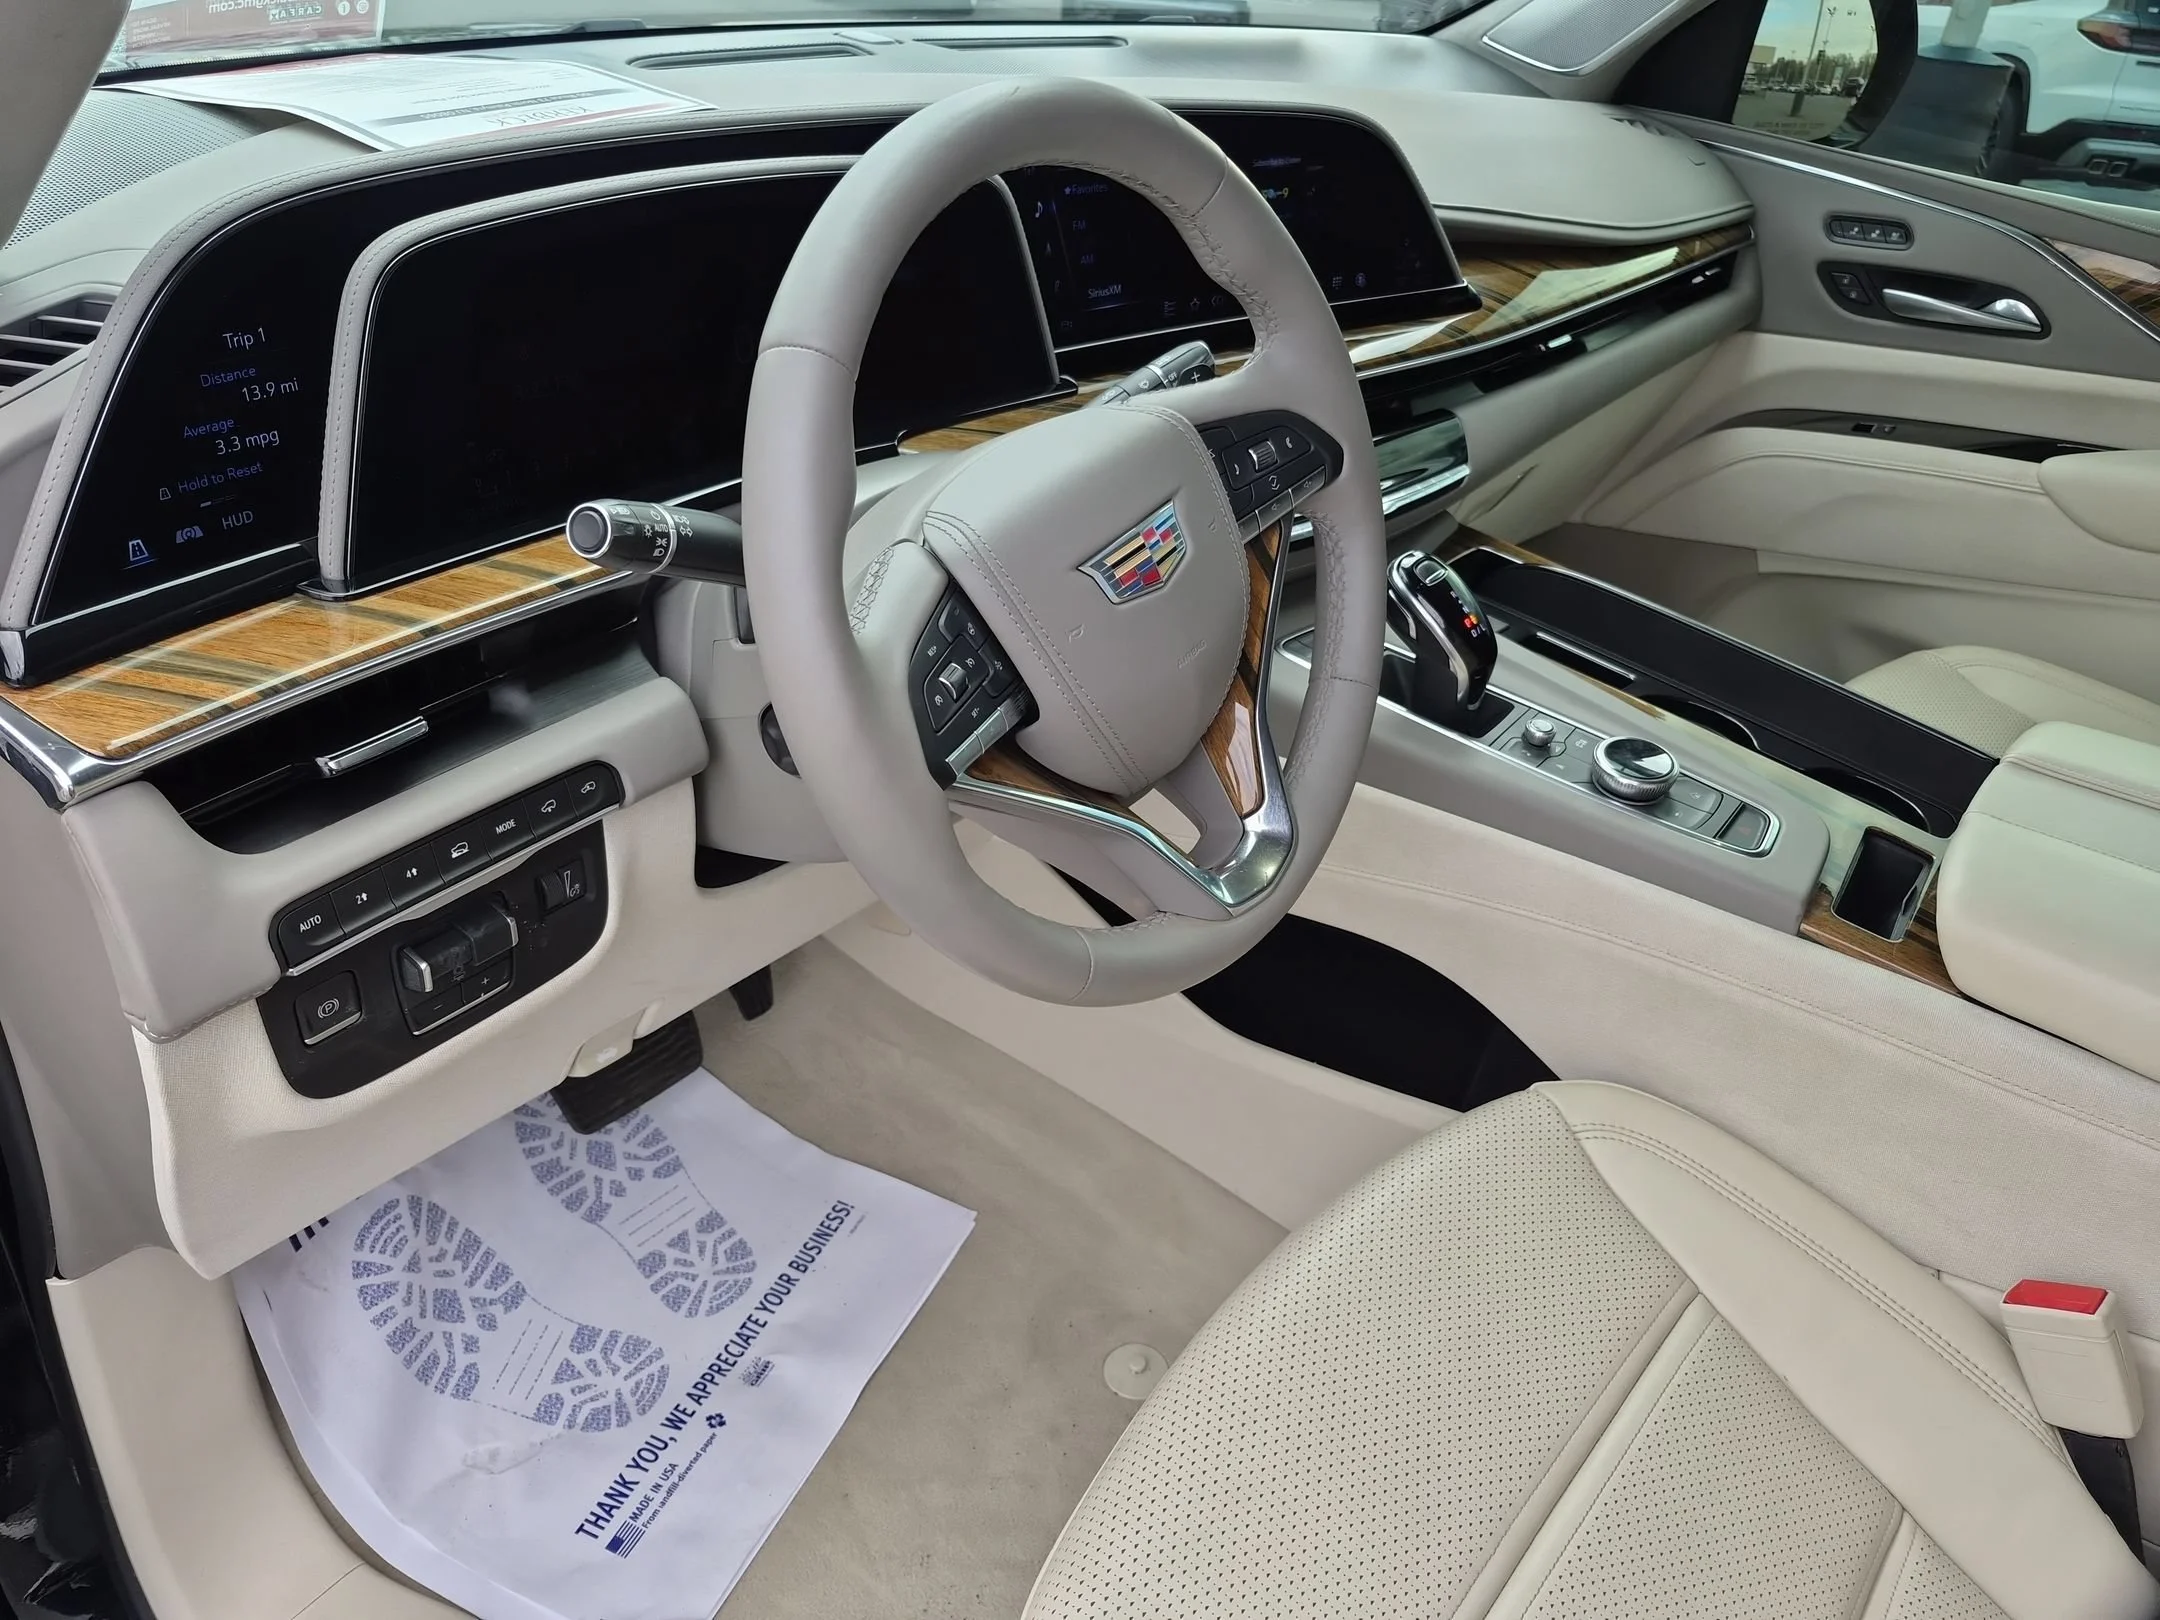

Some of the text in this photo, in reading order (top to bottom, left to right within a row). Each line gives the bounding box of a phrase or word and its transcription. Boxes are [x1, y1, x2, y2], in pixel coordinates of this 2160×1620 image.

[1072, 184, 1109, 194] Favorites
[1072, 220, 1087, 231] FM
[1080, 254, 1094, 265] AM
[1088, 284, 1122, 299] SiriusXM
[222, 328, 267, 350] Trip 1
[200, 366, 256, 387] Distance
[241, 377, 299, 402] 13.9 mi
[183, 417, 235, 439] Average
[215, 429, 280, 456] 3.3 mpg
[177, 461, 263, 494] Hold to Reset
[221, 510, 254, 531] HUD
[654, 523, 669, 533] AUTO
[495, 818, 517, 835] MODE
[299, 914, 323, 934] AUTO
[574, 1199, 856, 1541] THANK YOU, WE APPRECIATE YOUR BUSINESS!
[641, 1431, 718, 1529] From landfill-diverted paper
[628, 1462, 680, 1524] MADE IN USA
